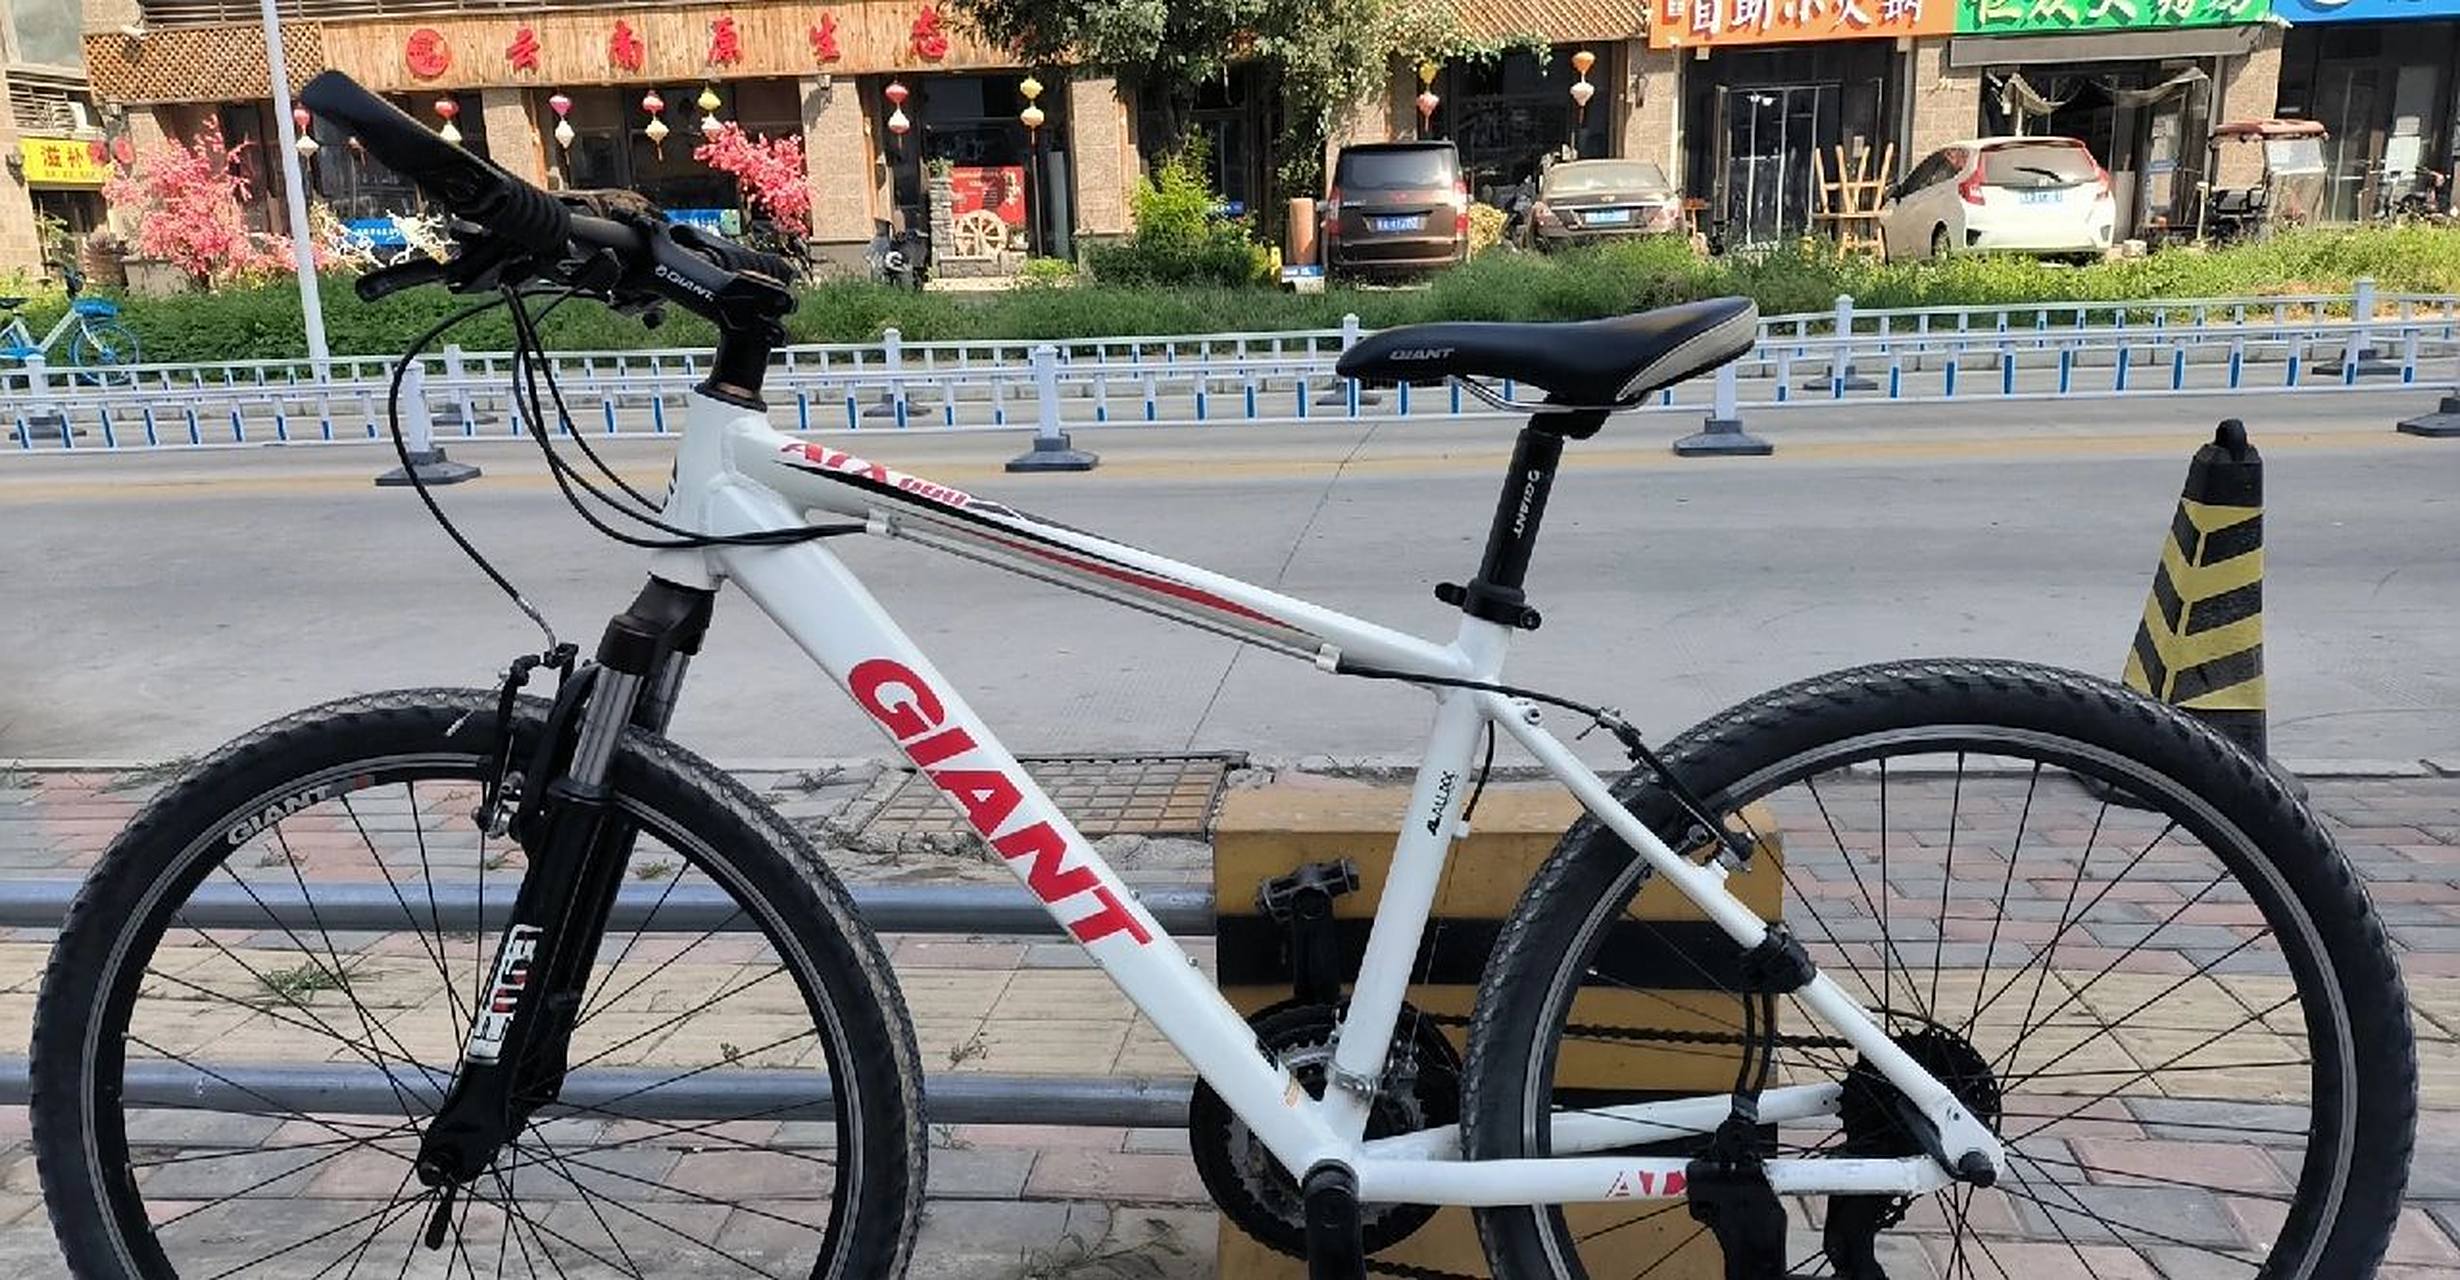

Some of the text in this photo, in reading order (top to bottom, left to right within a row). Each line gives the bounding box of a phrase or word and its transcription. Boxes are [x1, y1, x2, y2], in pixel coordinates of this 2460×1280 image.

[505, 5, 948, 74] 云南原生态
[666, 271, 715, 302] GIANT
[1389, 348, 1455, 360] GIANT
[1513, 482, 1536, 539] GIANT
[227, 785, 330, 845] GIANT
[848, 657, 1154, 944] GIANT
